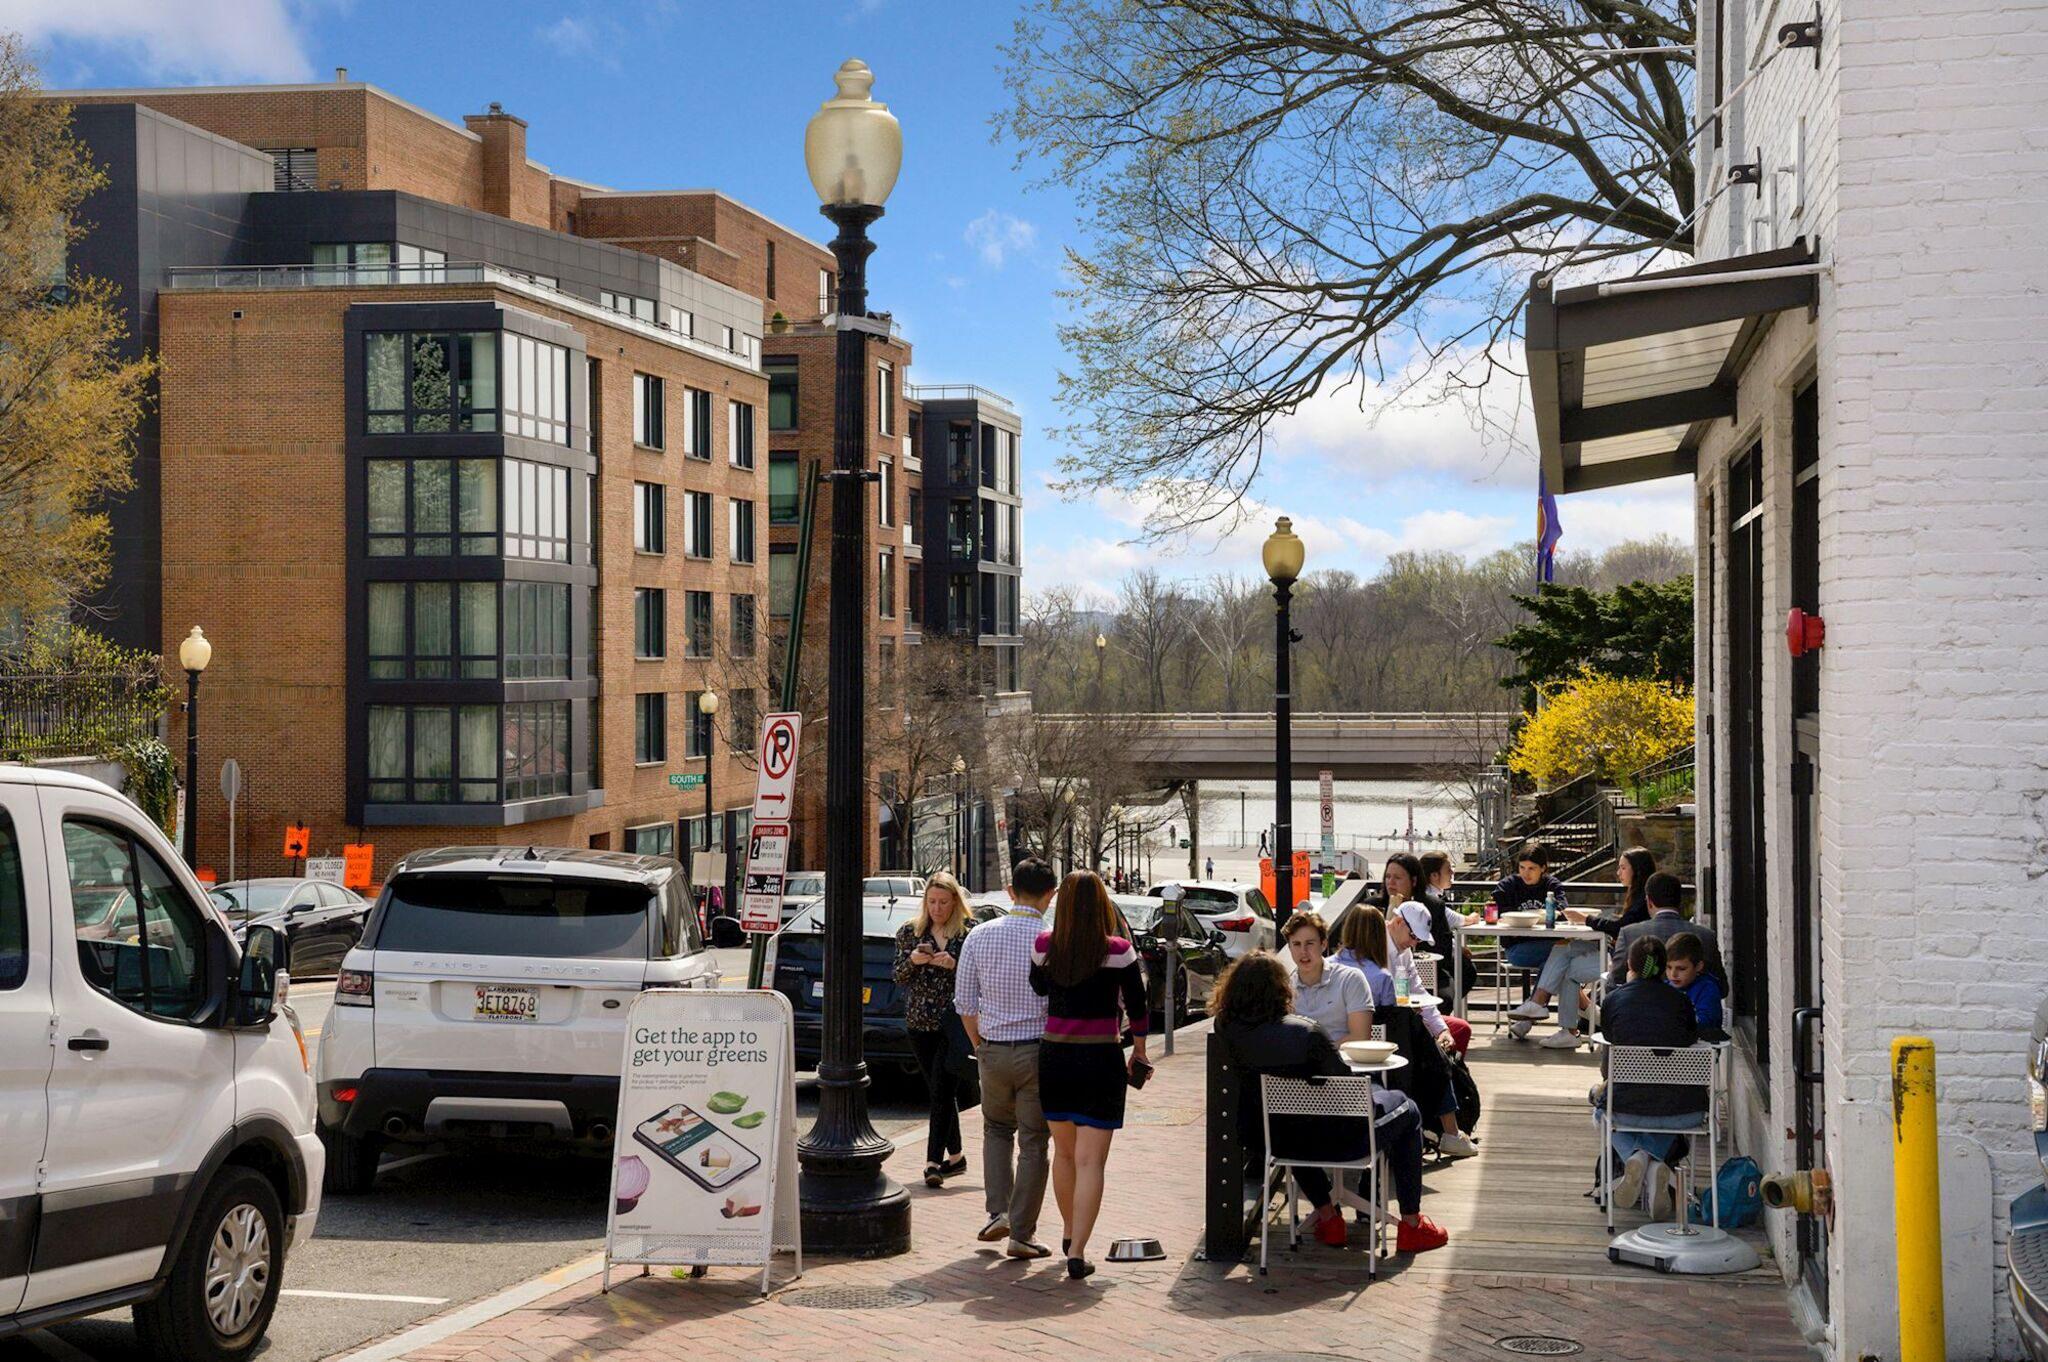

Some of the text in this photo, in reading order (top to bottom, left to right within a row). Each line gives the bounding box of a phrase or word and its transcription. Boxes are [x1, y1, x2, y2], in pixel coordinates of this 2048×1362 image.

[671, 775, 697, 784] SOUTH
[774, 827, 785, 835] ZONE
[752, 838, 760, 858] 2
[761, 841, 777, 850] HOUR
[309, 861, 344, 870] ROAD CLOSED
[524, 965, 601, 976] ROVER
[477, 995, 537, 1013] 3ET8768
[635, 1027, 758, 1049] Get the app to
[632, 1049, 768, 1067] get your greens
